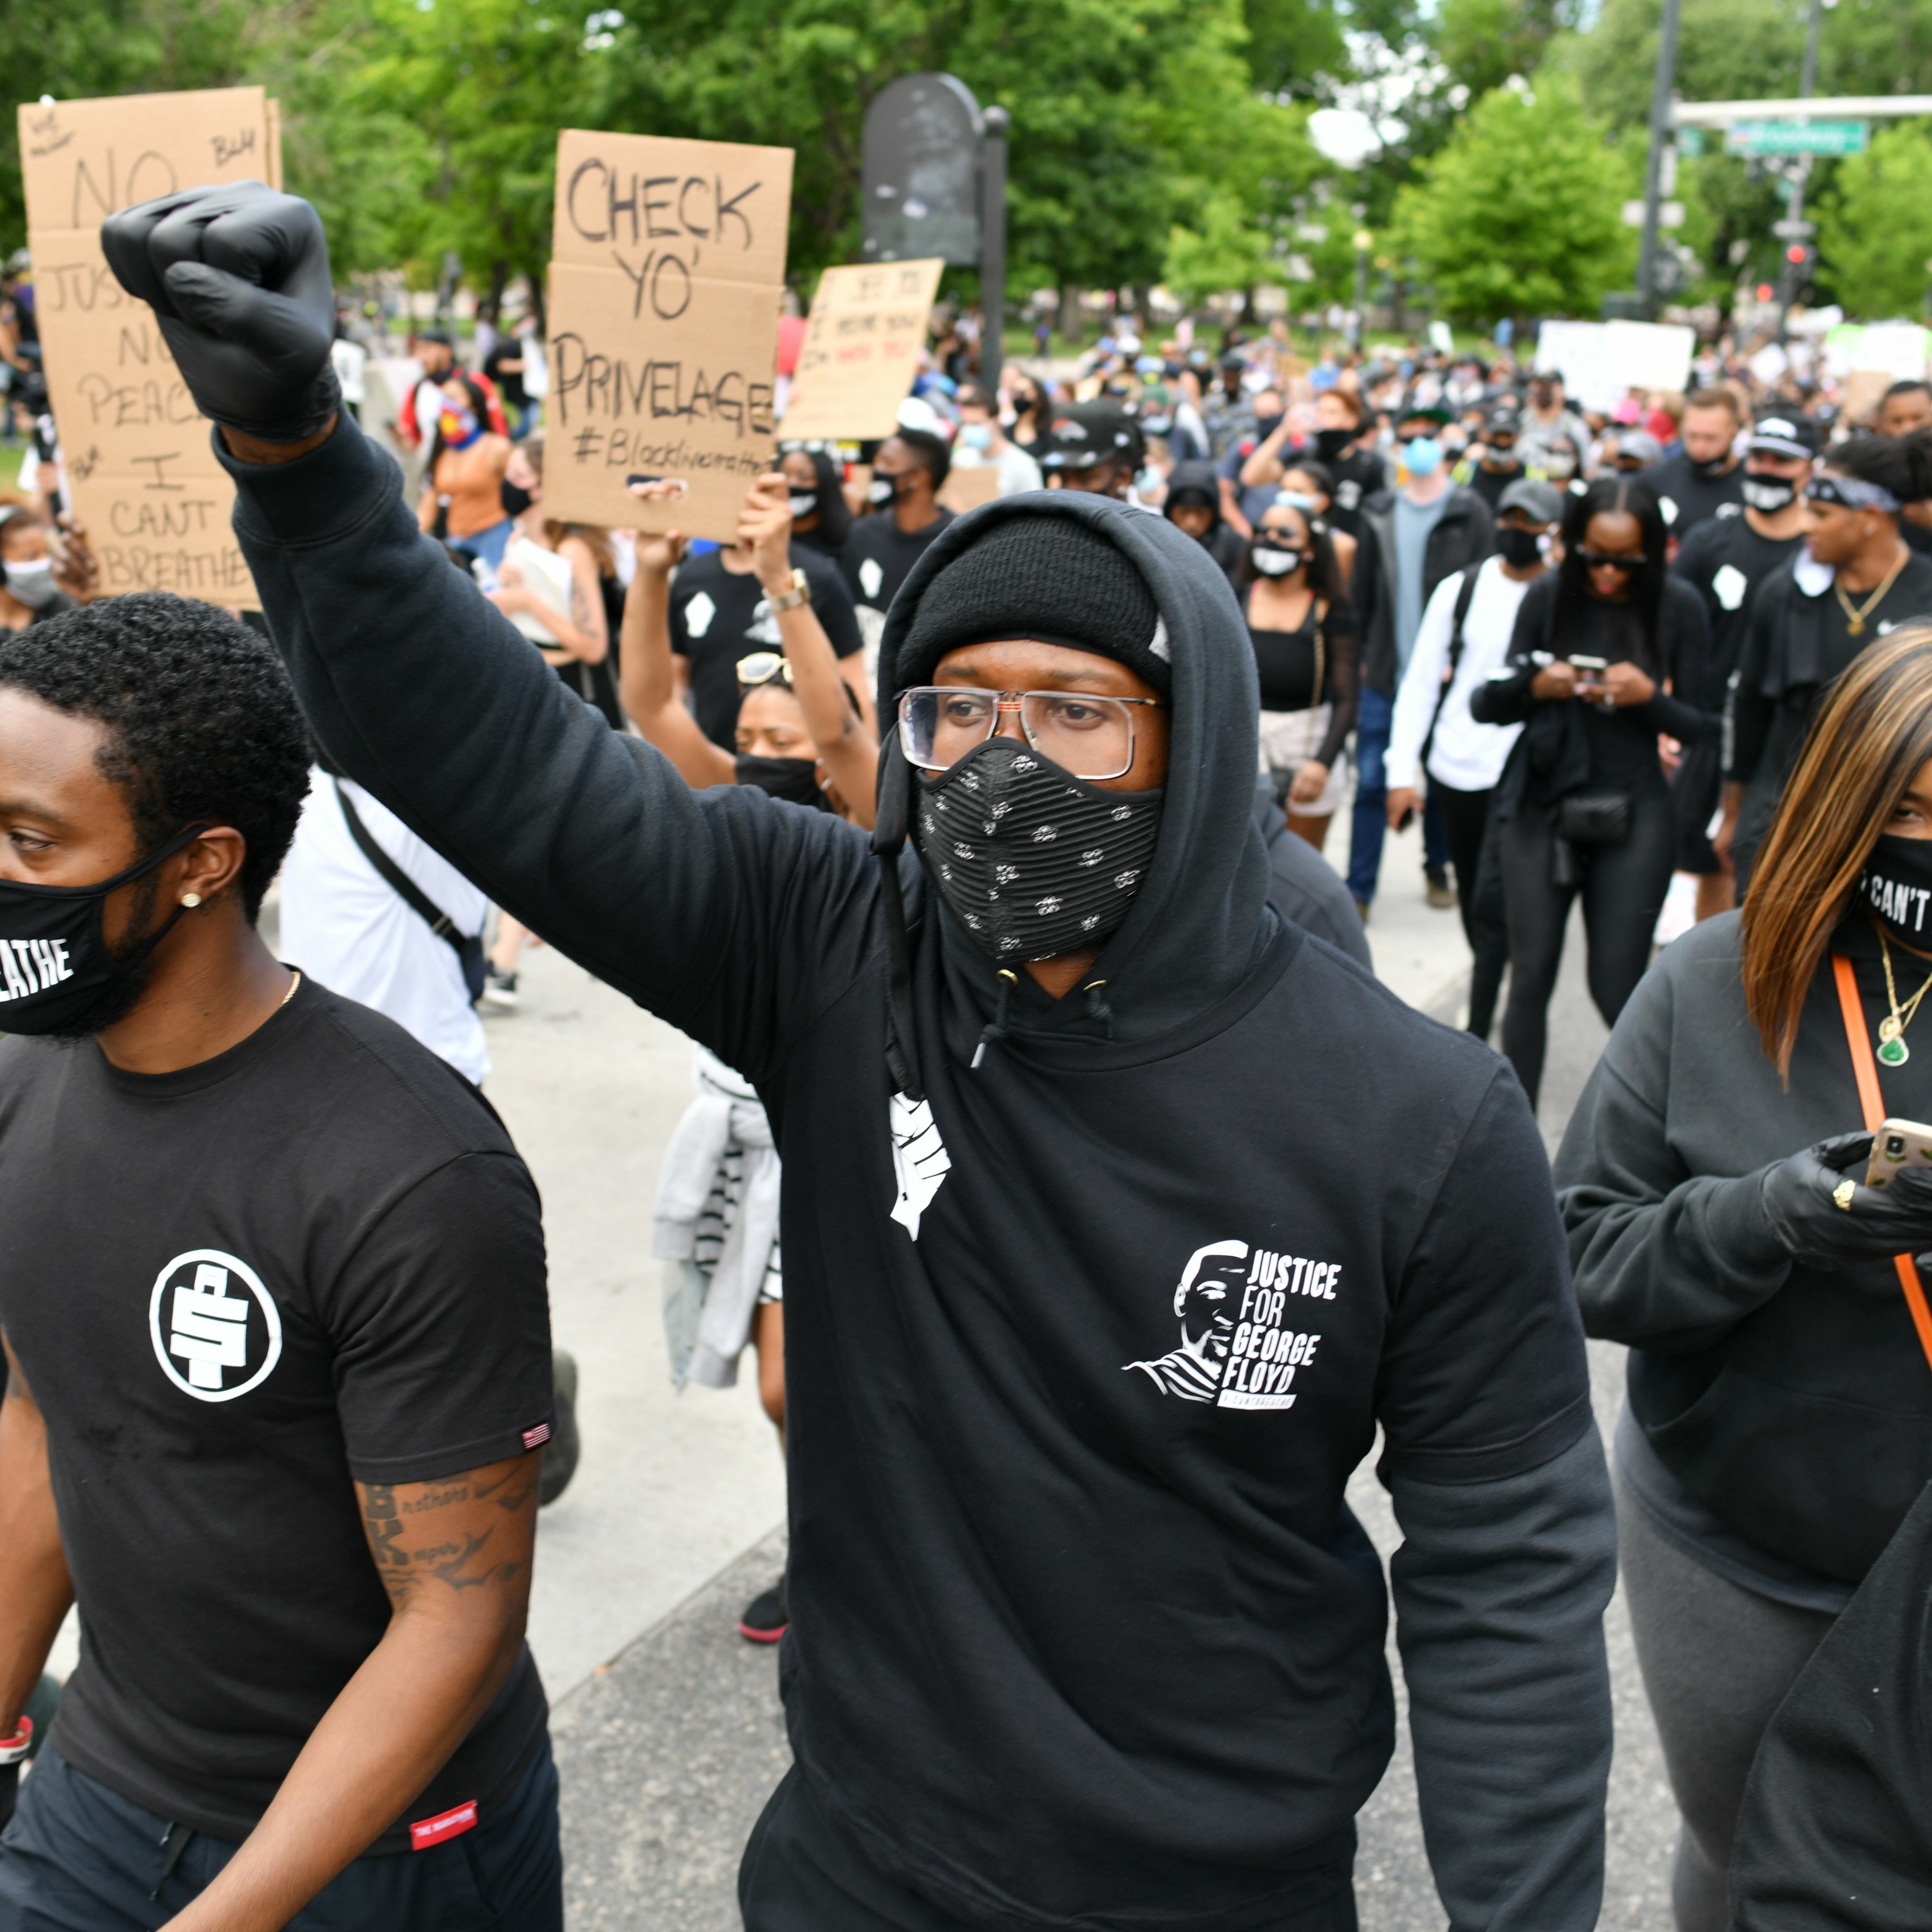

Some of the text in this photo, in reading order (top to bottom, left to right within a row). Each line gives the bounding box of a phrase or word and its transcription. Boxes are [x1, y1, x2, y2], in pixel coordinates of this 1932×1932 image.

[569, 157, 762, 251] CHECK
[612, 245, 699, 319] YO'
[78, 372, 209, 428] PEAC
[552, 332, 773, 439] PRIVELAGE
[109, 499, 217, 538] CANT
[1870, 874, 1931, 932] CAN'T
[1247, 1249, 1342, 1300] JUSTICE
[1239, 1285, 1286, 1328] FOR
[1231, 1321, 1321, 1367] GEORGE
[1221, 1355, 1296, 1394] FLOYD
